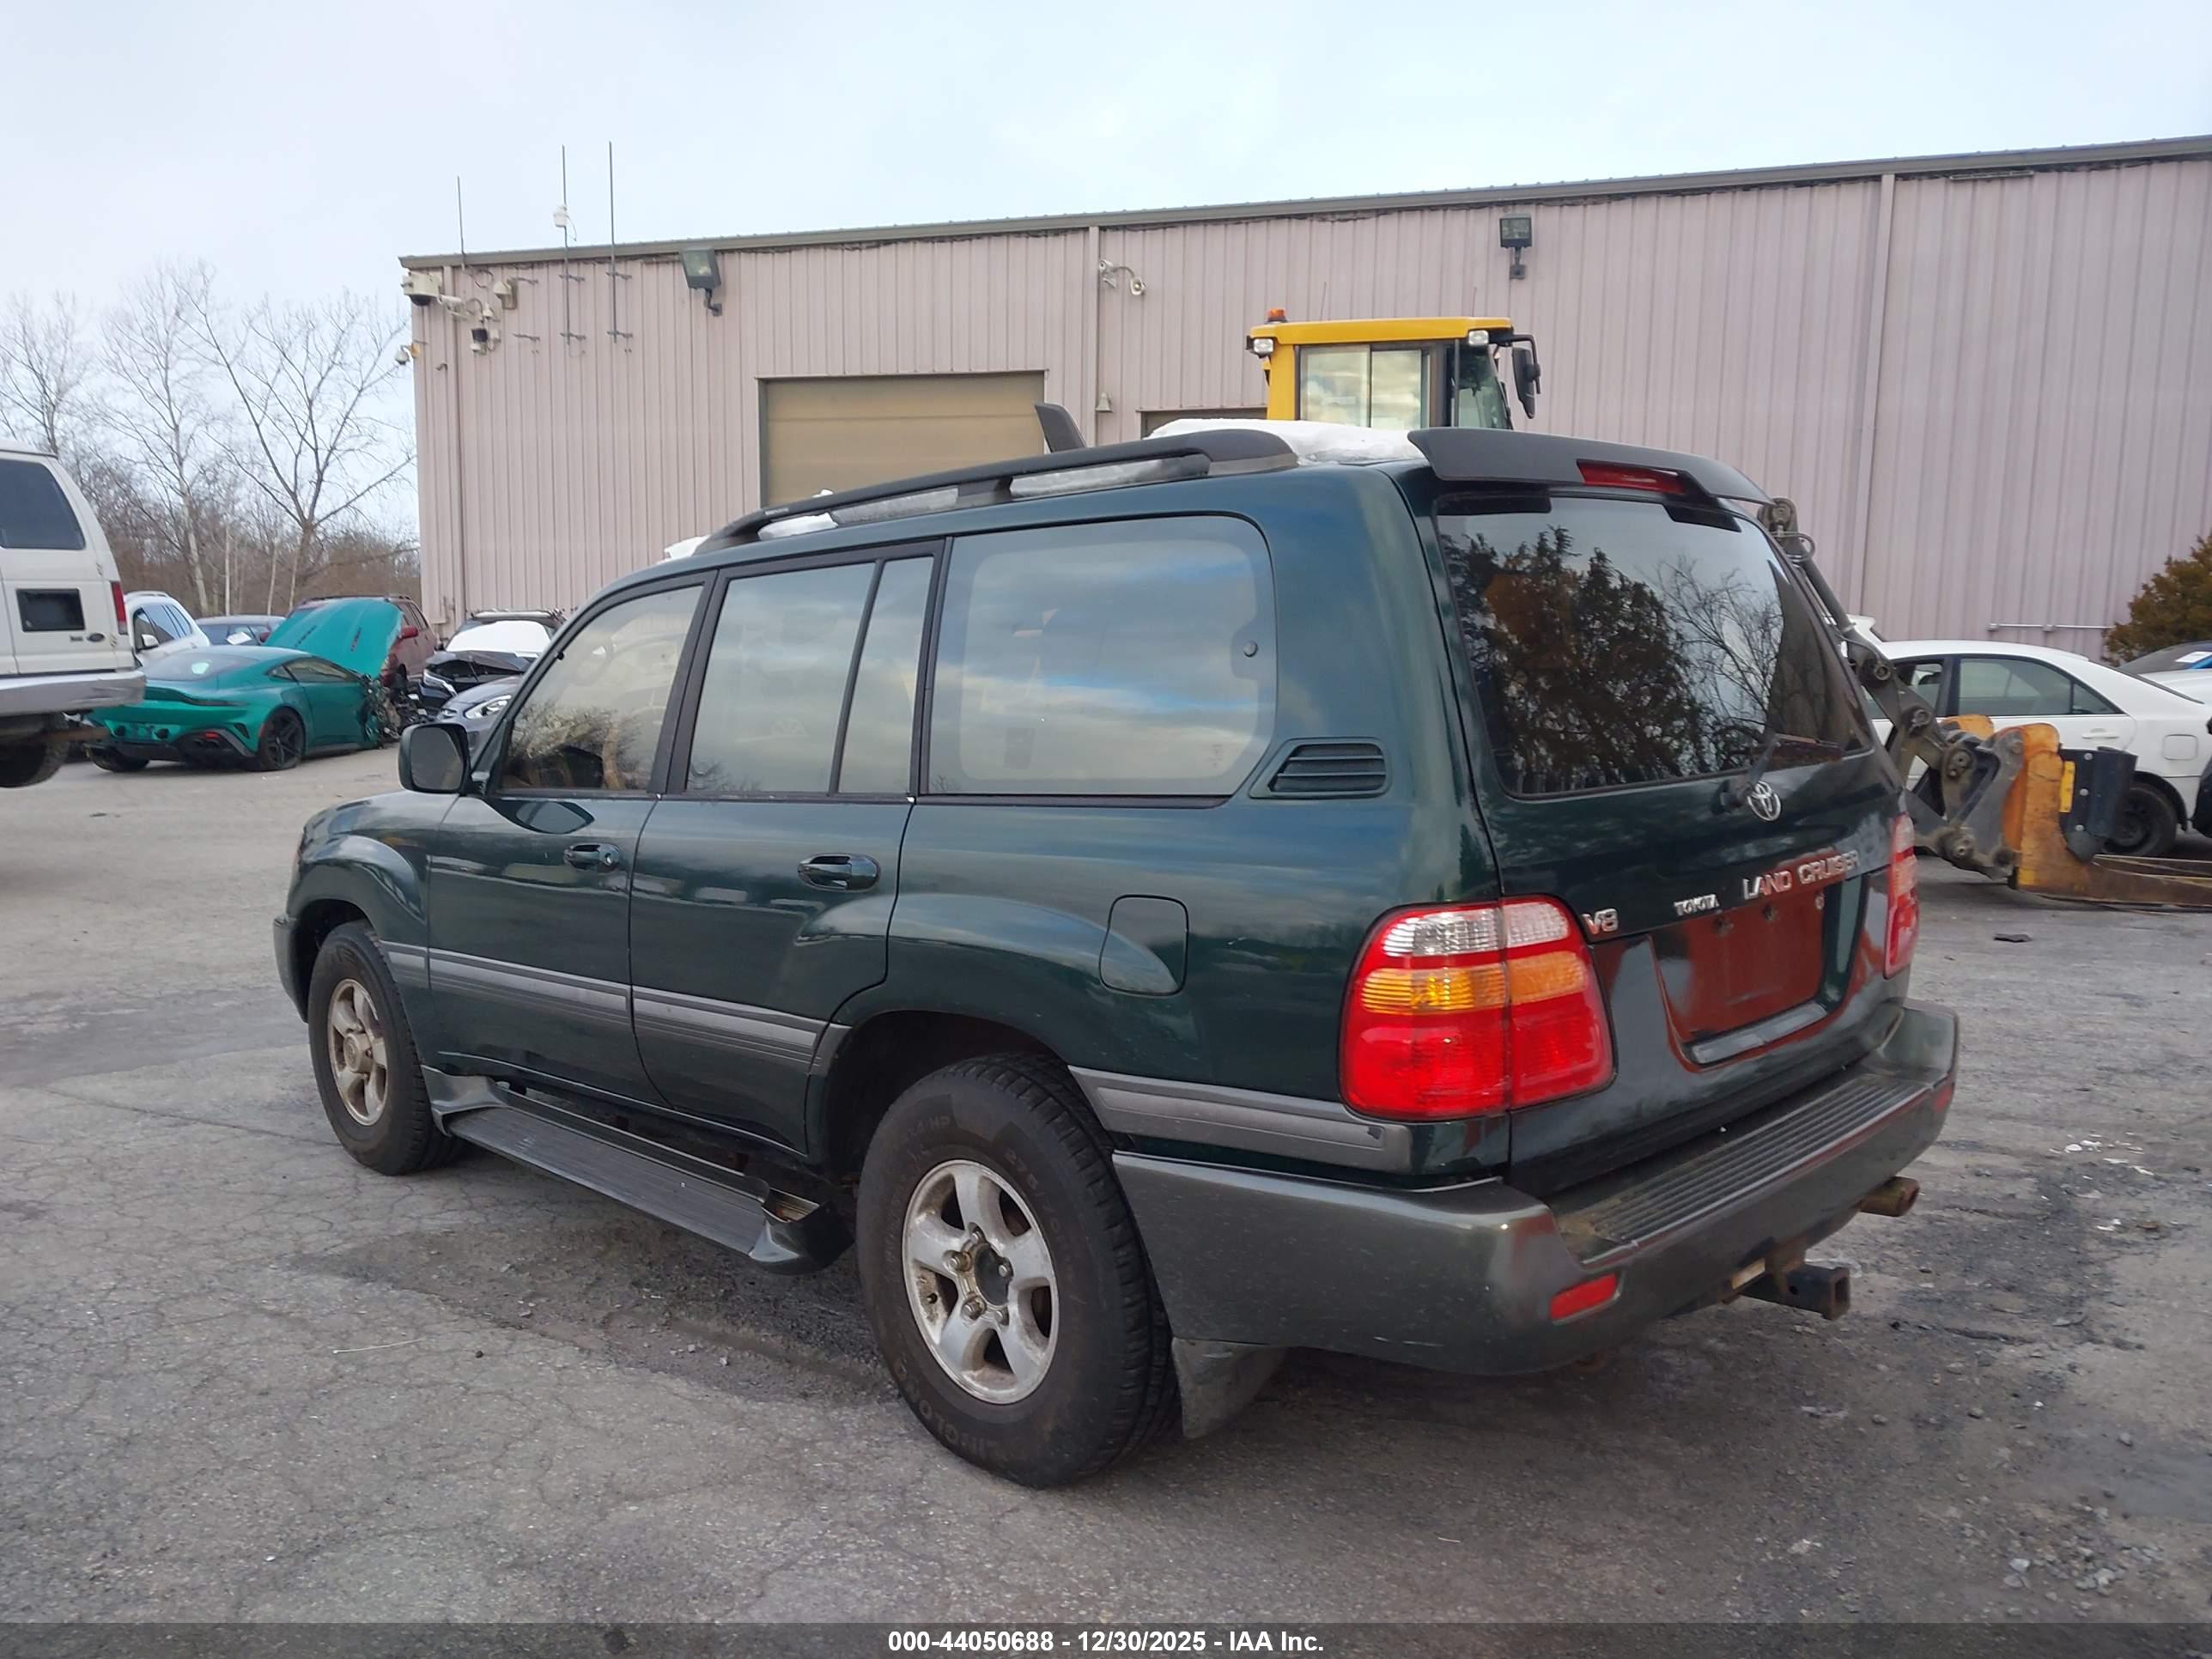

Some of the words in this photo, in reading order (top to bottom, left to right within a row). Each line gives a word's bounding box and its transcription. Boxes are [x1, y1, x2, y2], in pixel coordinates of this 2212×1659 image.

[1742, 871, 1794, 900] LAND
[1798, 850, 1860, 884] CRUISER
[1674, 894, 1720, 916] TOYOTA
[1583, 908, 1620, 935] V8
